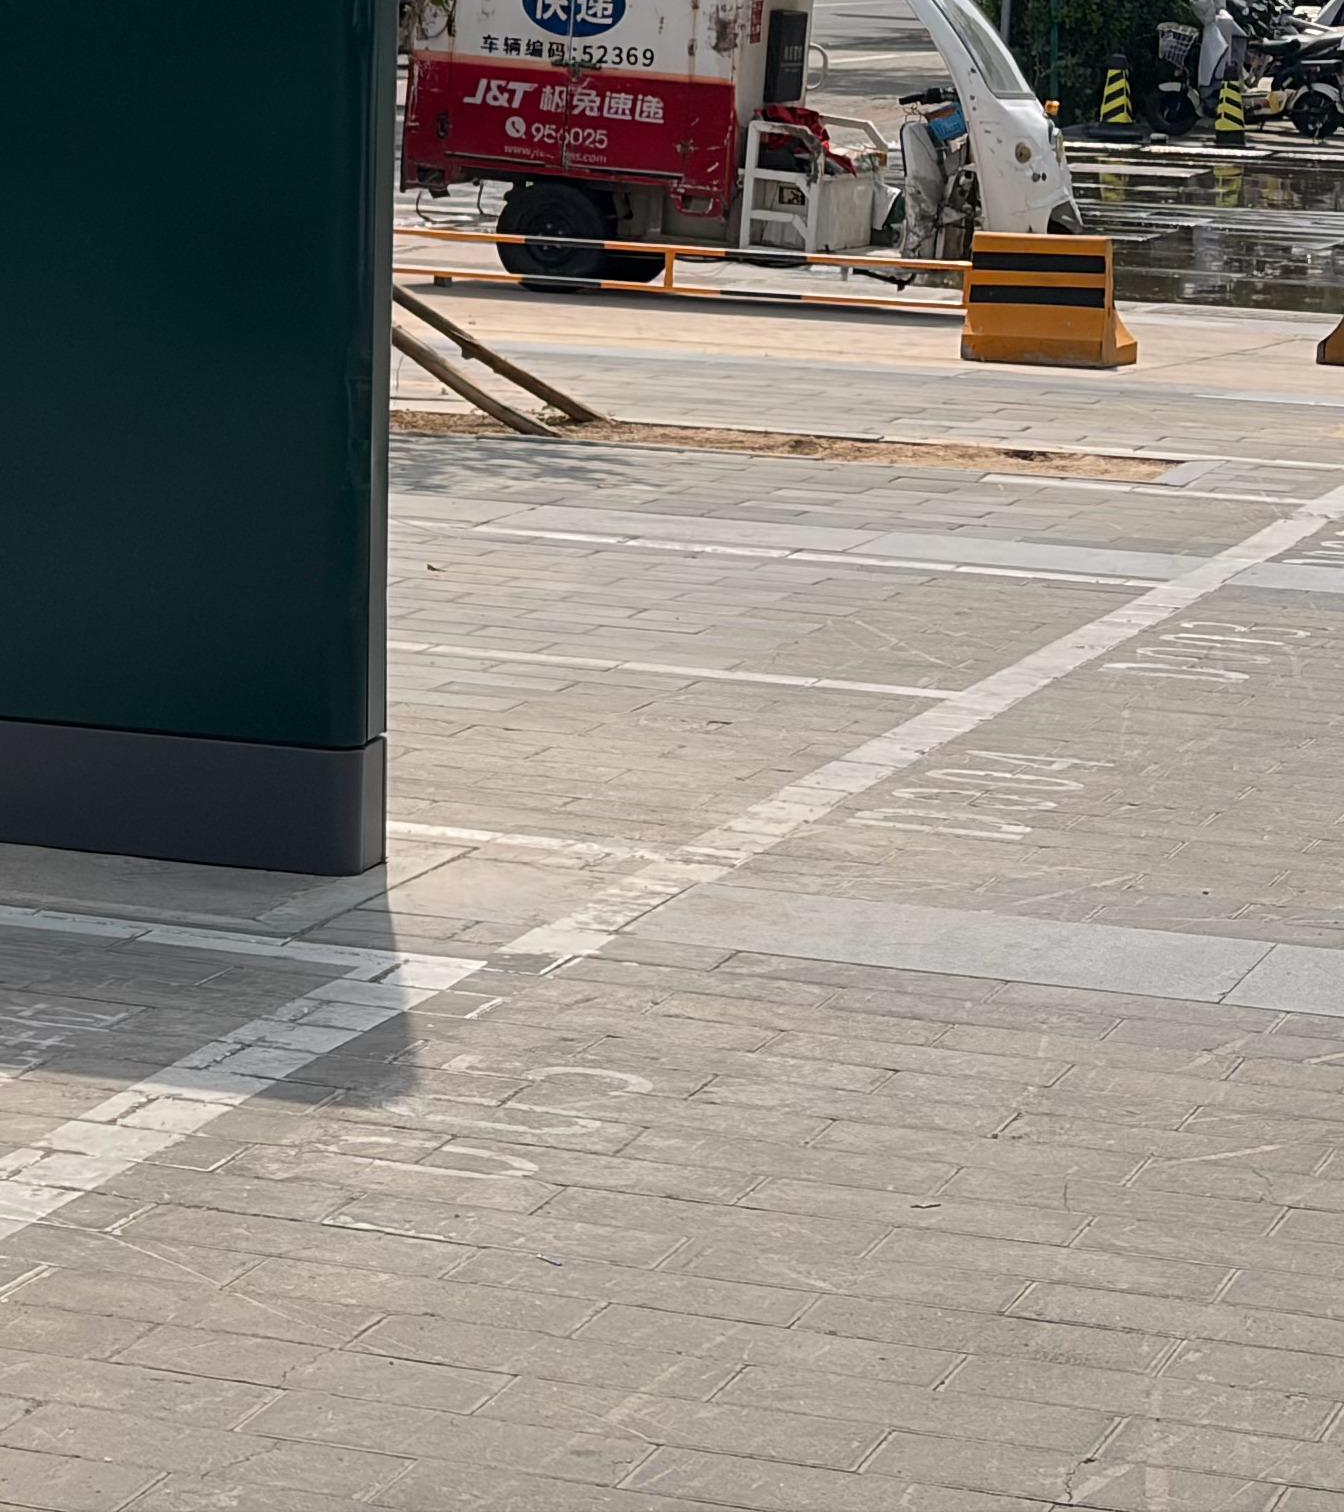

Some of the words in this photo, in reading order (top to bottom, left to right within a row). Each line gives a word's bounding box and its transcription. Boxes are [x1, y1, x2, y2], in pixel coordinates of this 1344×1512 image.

[462, 78, 539, 109] J&T
[540, 85, 665, 125] 极兔速递
[531, 123, 609, 148] 956025
